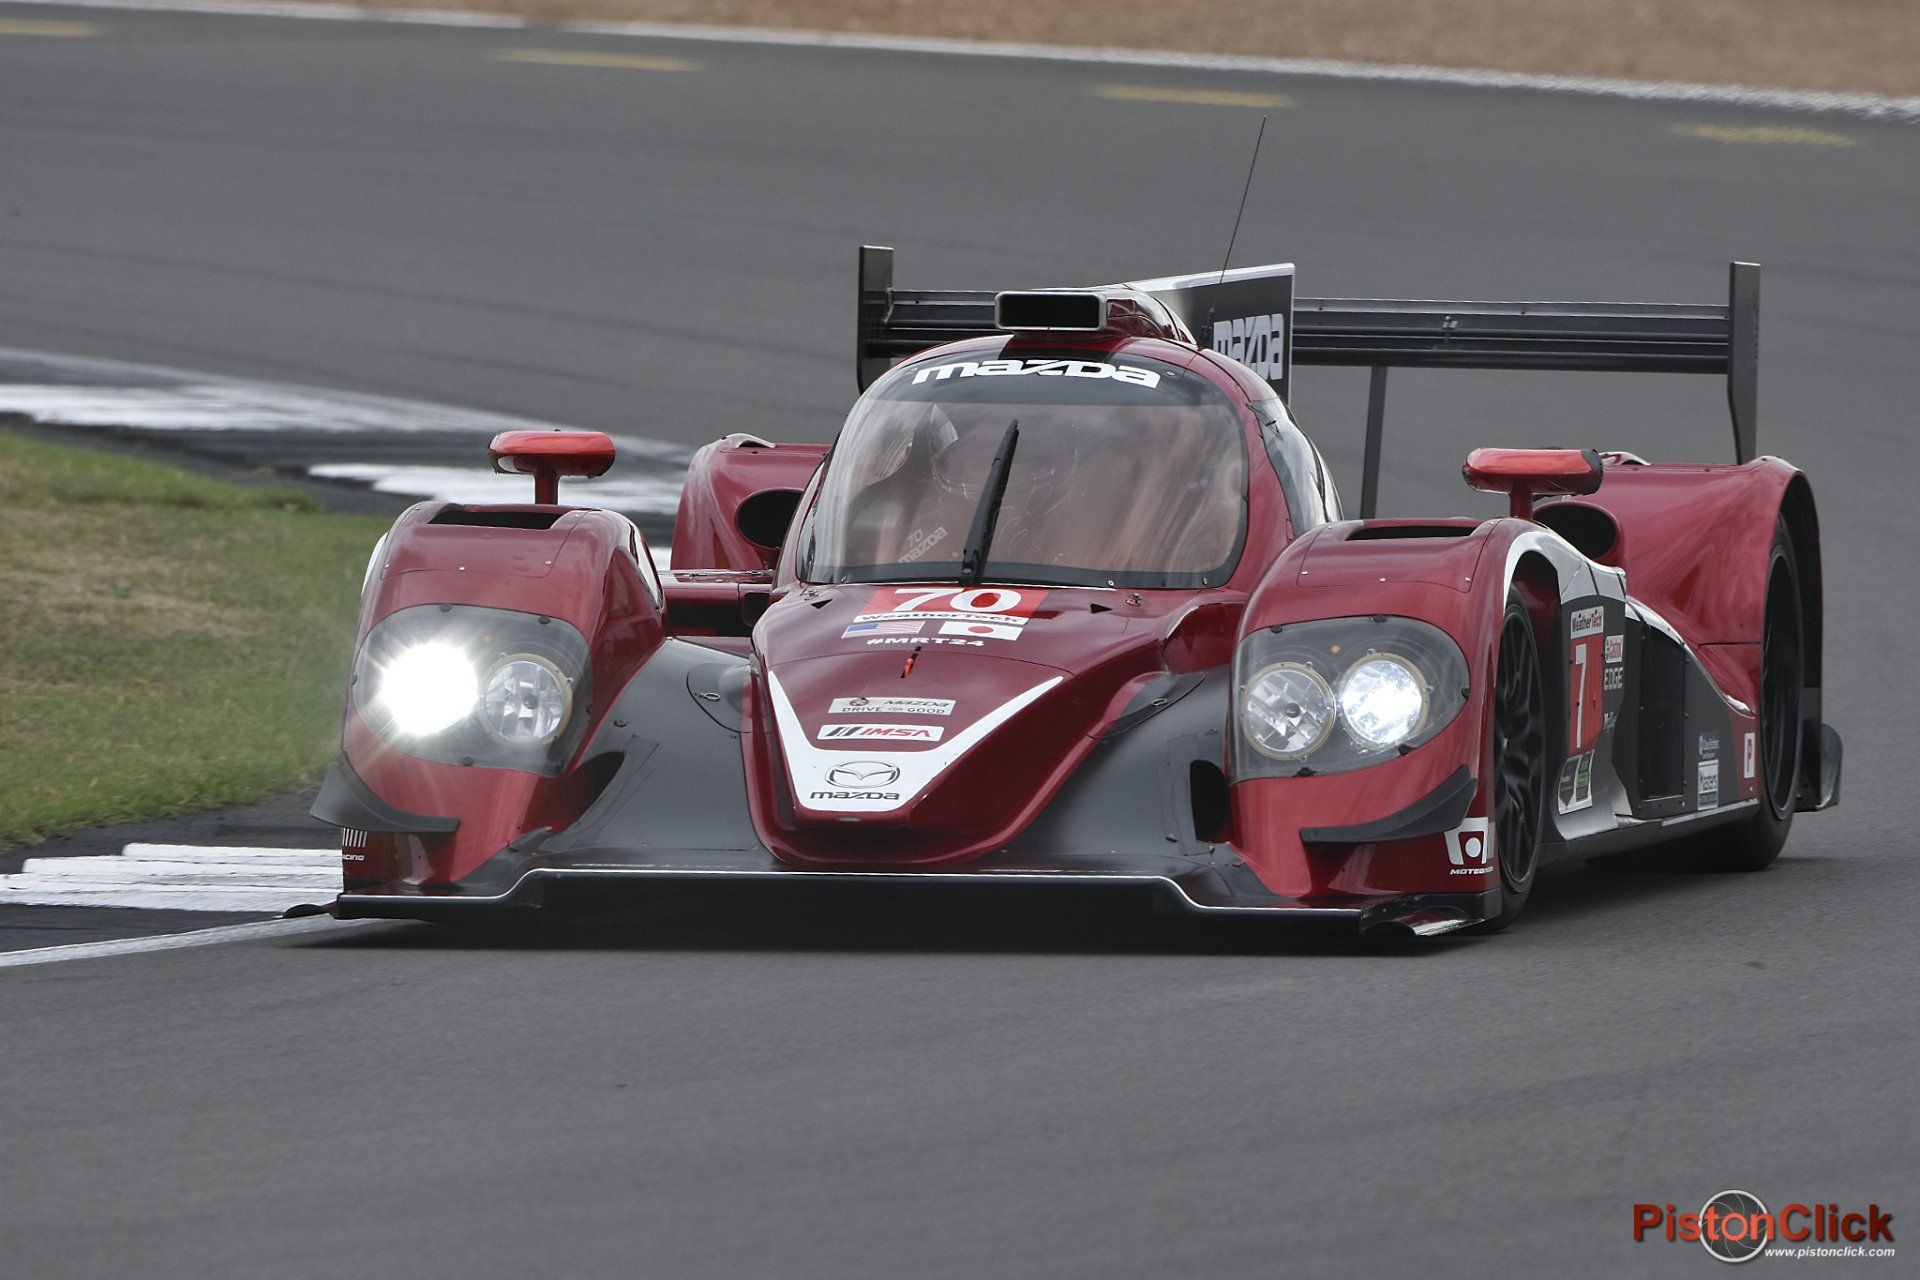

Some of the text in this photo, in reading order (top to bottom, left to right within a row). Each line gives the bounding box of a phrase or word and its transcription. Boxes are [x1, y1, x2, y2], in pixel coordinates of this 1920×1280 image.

[912, 359, 1161, 389] mazda
[898, 527, 948, 563] mazda
[906, 529, 924, 548] 70
[893, 588, 1022, 613] 70
[861, 612, 1019, 624] WeatherTech
[1571, 611, 1602, 632] WeatherTech
[867, 638, 985, 647] #MRT24
[1604, 667, 1624, 690] EDGE
[859, 727, 932, 738] IMSA
[810, 791, 900, 801] mazda
